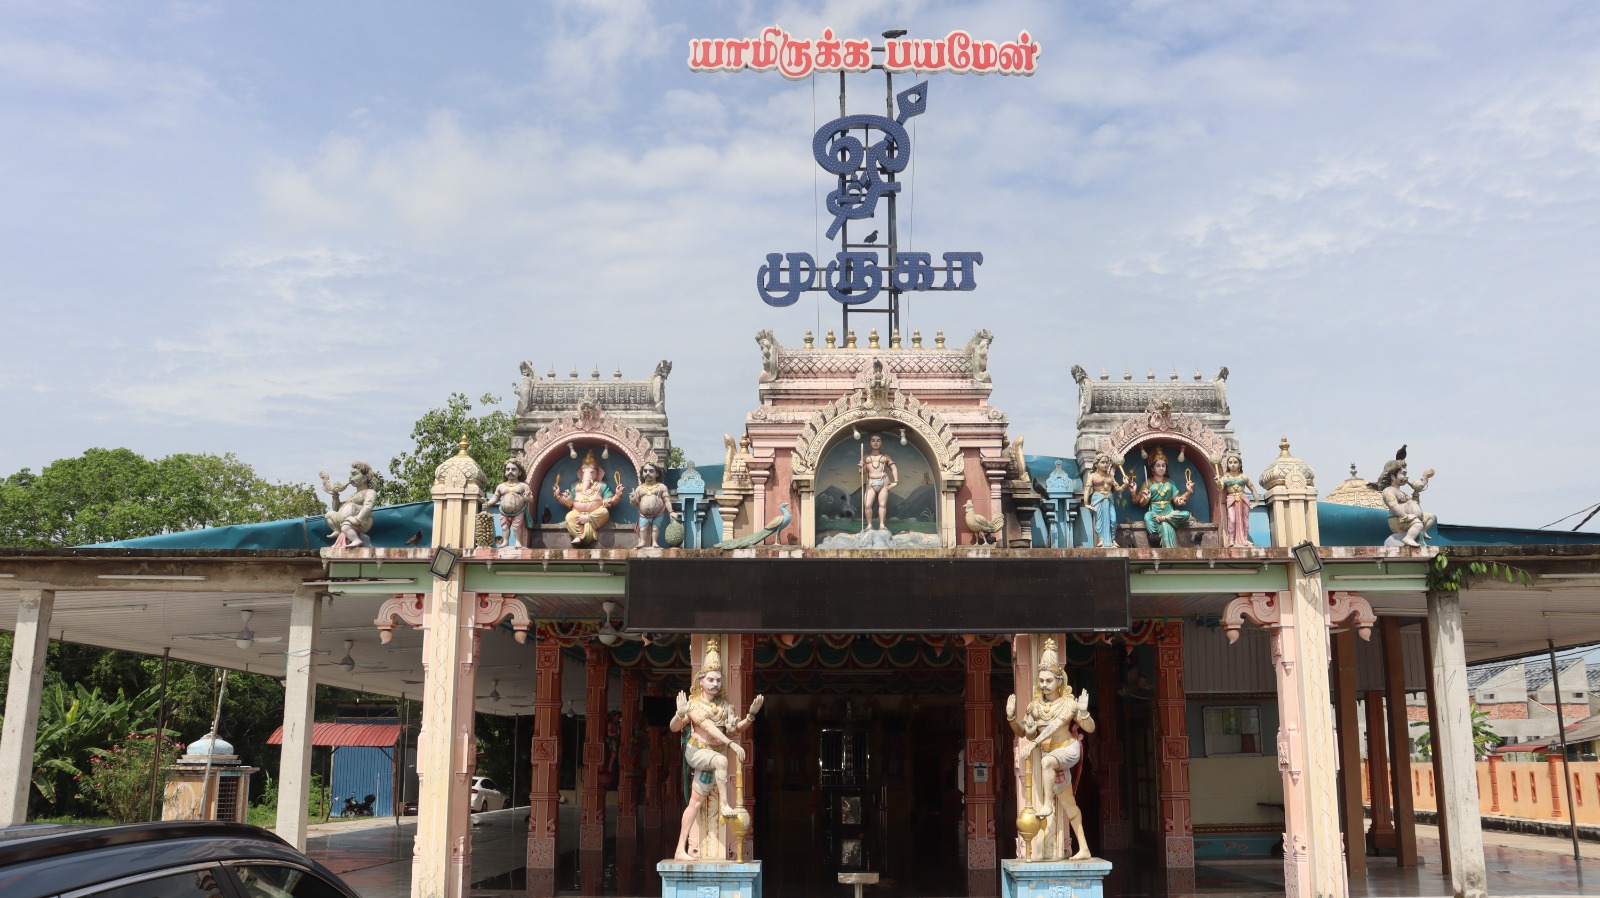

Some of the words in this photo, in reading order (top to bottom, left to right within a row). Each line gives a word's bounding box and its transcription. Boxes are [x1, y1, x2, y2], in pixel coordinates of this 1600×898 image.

[691, 28, 871, 77] யாமிருக்க
[887, 32, 1038, 71] பயமேன்
[757, 251, 984, 307] முருகா
